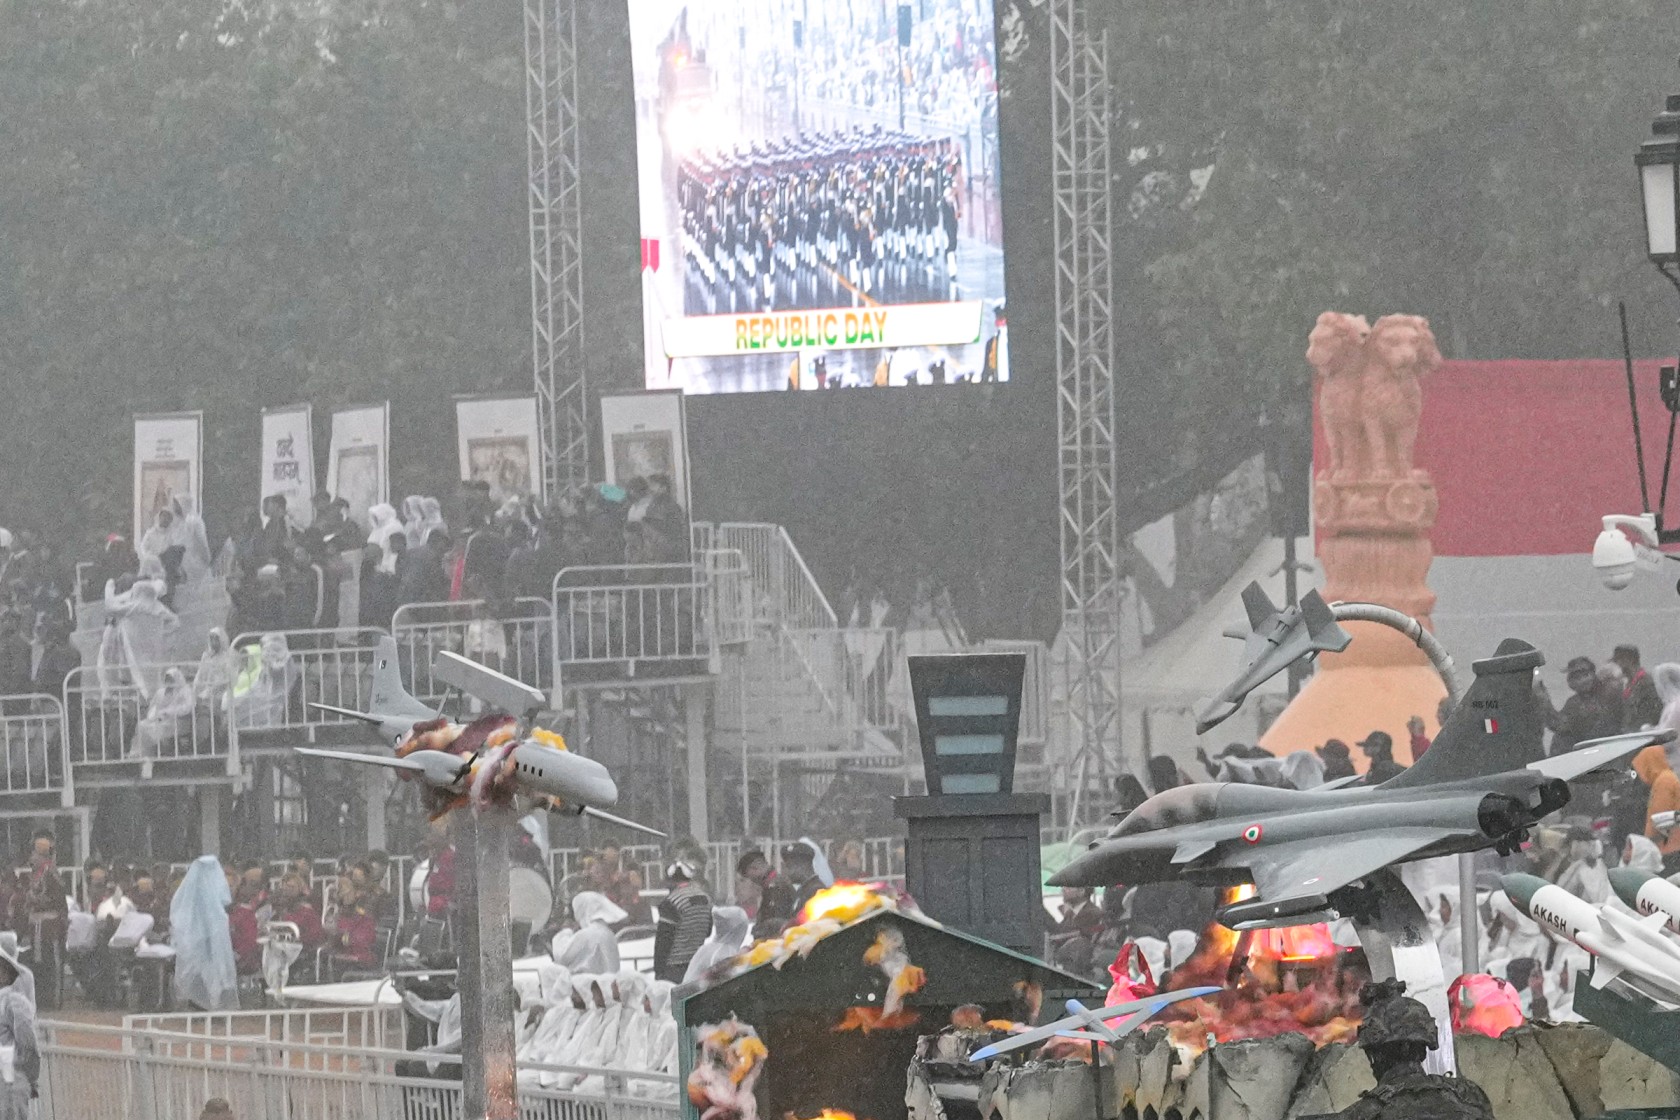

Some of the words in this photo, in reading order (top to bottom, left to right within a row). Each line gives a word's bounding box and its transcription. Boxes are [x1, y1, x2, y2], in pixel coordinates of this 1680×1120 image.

[736, 314, 838, 350] REPUBLIC
[845, 311, 887, 344] DAY
[1534, 903, 1567, 933] AKASH
